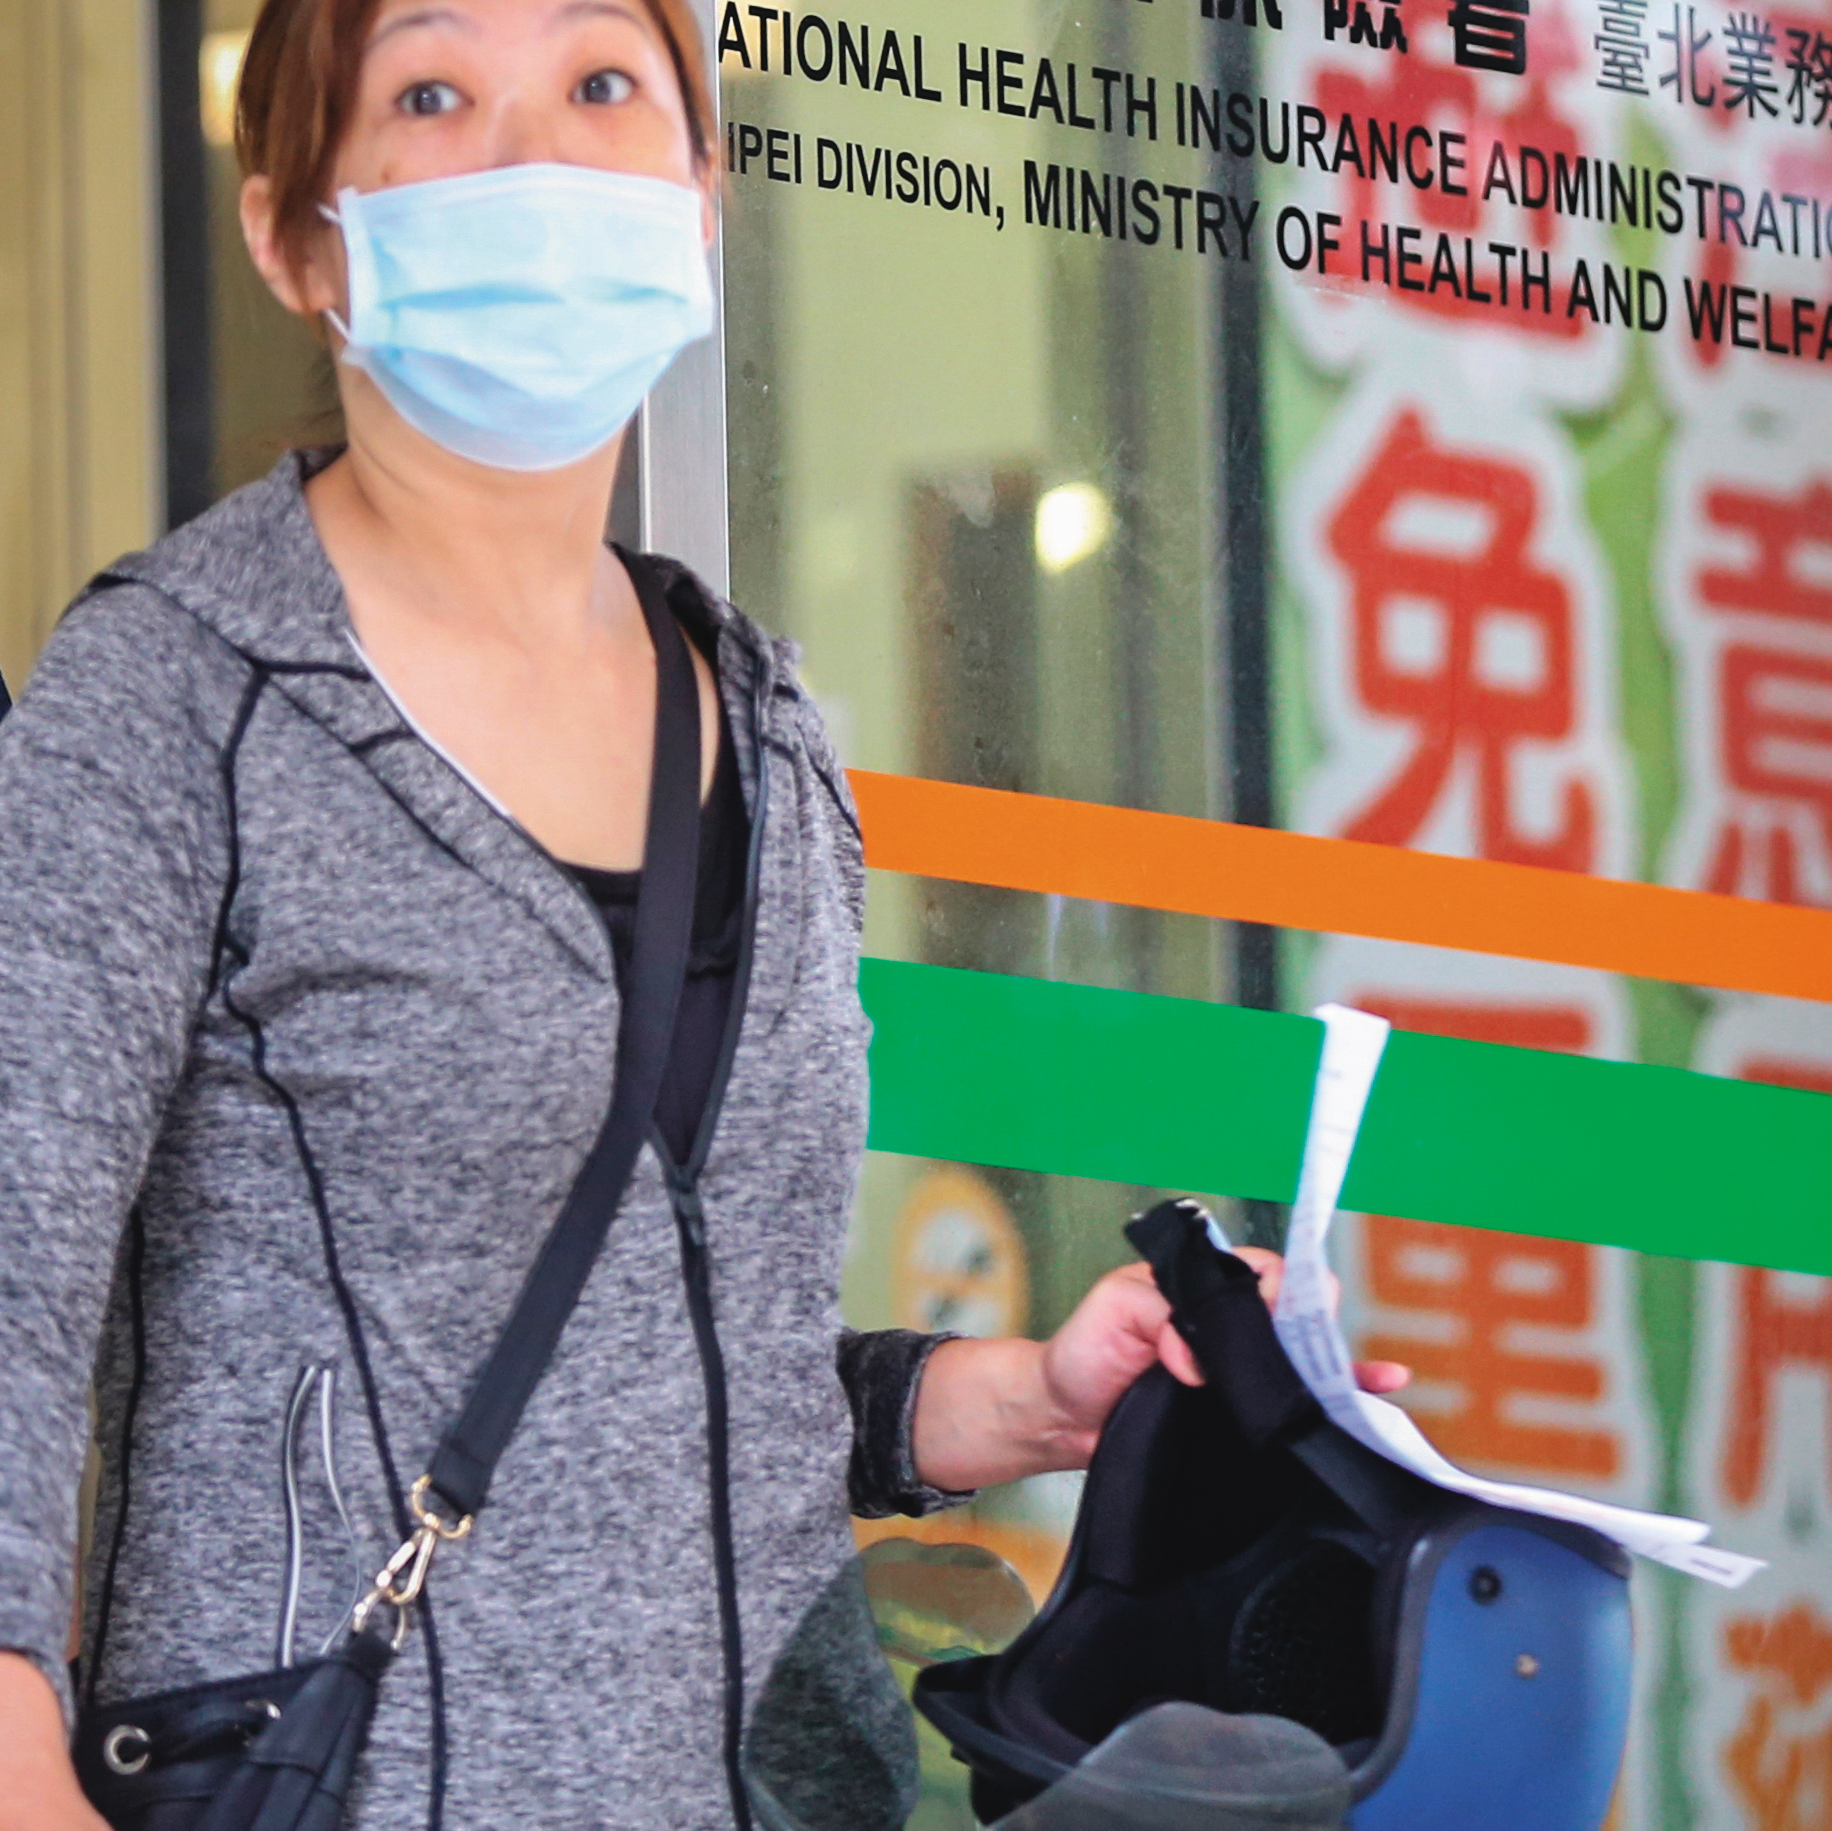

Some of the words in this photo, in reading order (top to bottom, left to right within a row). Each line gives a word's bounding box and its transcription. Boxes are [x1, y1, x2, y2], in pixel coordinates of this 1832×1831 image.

[719, 1, 941, 102] ATIONAL
[959, 42, 1157, 141] HEALTH
[1177, 82, 1468, 196] INSURANCE
[817, 138, 1005, 232] DIVISION,
[1024, 161, 1260, 261] MINISTRY
[1276, 207, 1341, 273] OF
[1360, 220, 1550, 314] HEALTH
[1567, 258, 1667, 333] AND
